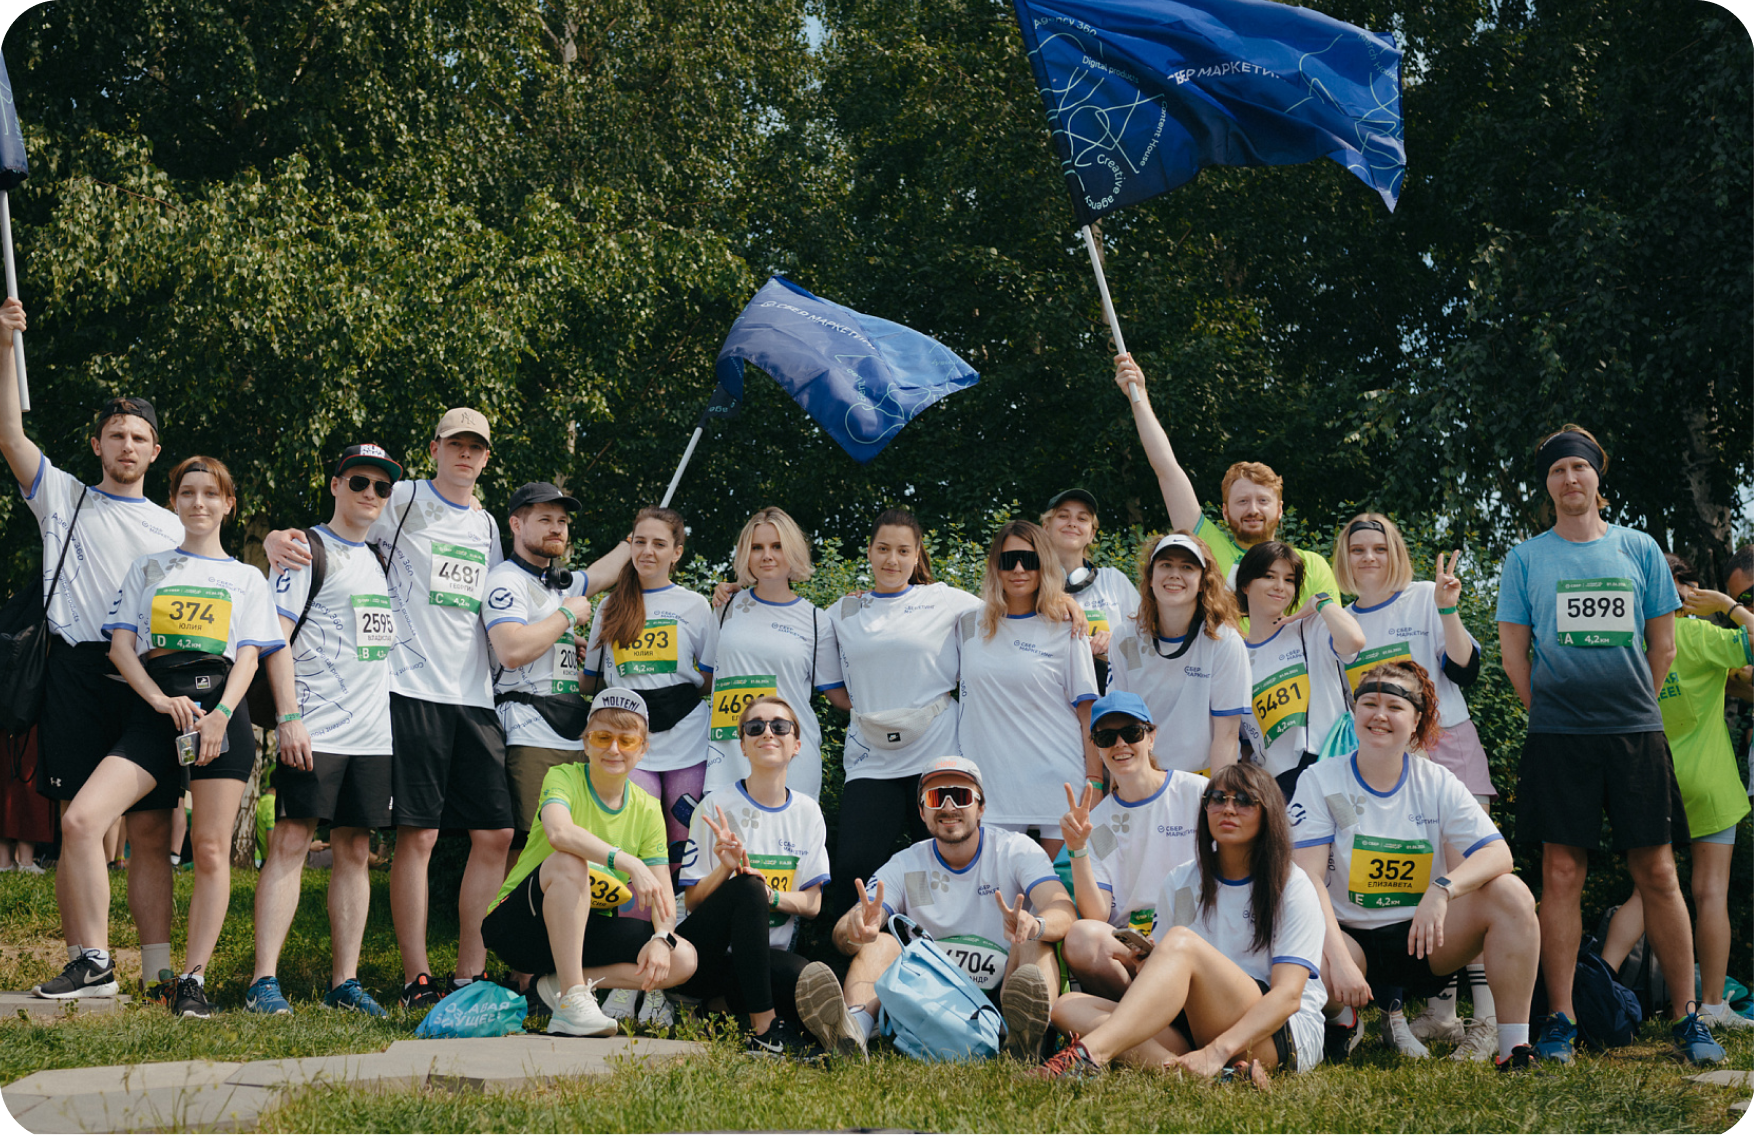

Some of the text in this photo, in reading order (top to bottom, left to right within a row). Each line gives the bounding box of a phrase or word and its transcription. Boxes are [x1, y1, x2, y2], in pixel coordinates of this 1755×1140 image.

[1033, 16, 1097, 36] Agency 360
[1081, 55, 1139, 84] Digital products
[1139, 100, 1168, 167] Content House
[1084, 153, 1126, 210] Creative agency
[74, 542, 84, 561] 360
[438, 562, 481, 588] 4681
[435, 593, 444, 604] C
[1567, 597, 1626, 618] 5898
[169, 601, 215, 625] 374
[329, 613, 344, 631] 360
[362, 612, 394, 634] 2595
[178, 622, 202, 631] ЮЛИЯ
[157, 634, 167, 647] D
[1564, 632, 1574, 645] A
[602, 696, 640, 712] MOLTENI
[718, 693, 765, 714] 469
[1256, 682, 1302, 720] 5481
[715, 728, 723, 739] C
[1368, 858, 1416, 880] 352
[1367, 881, 1413, 889] ЕЛИЗАВЕТА
[1355, 893, 1365, 906] E
